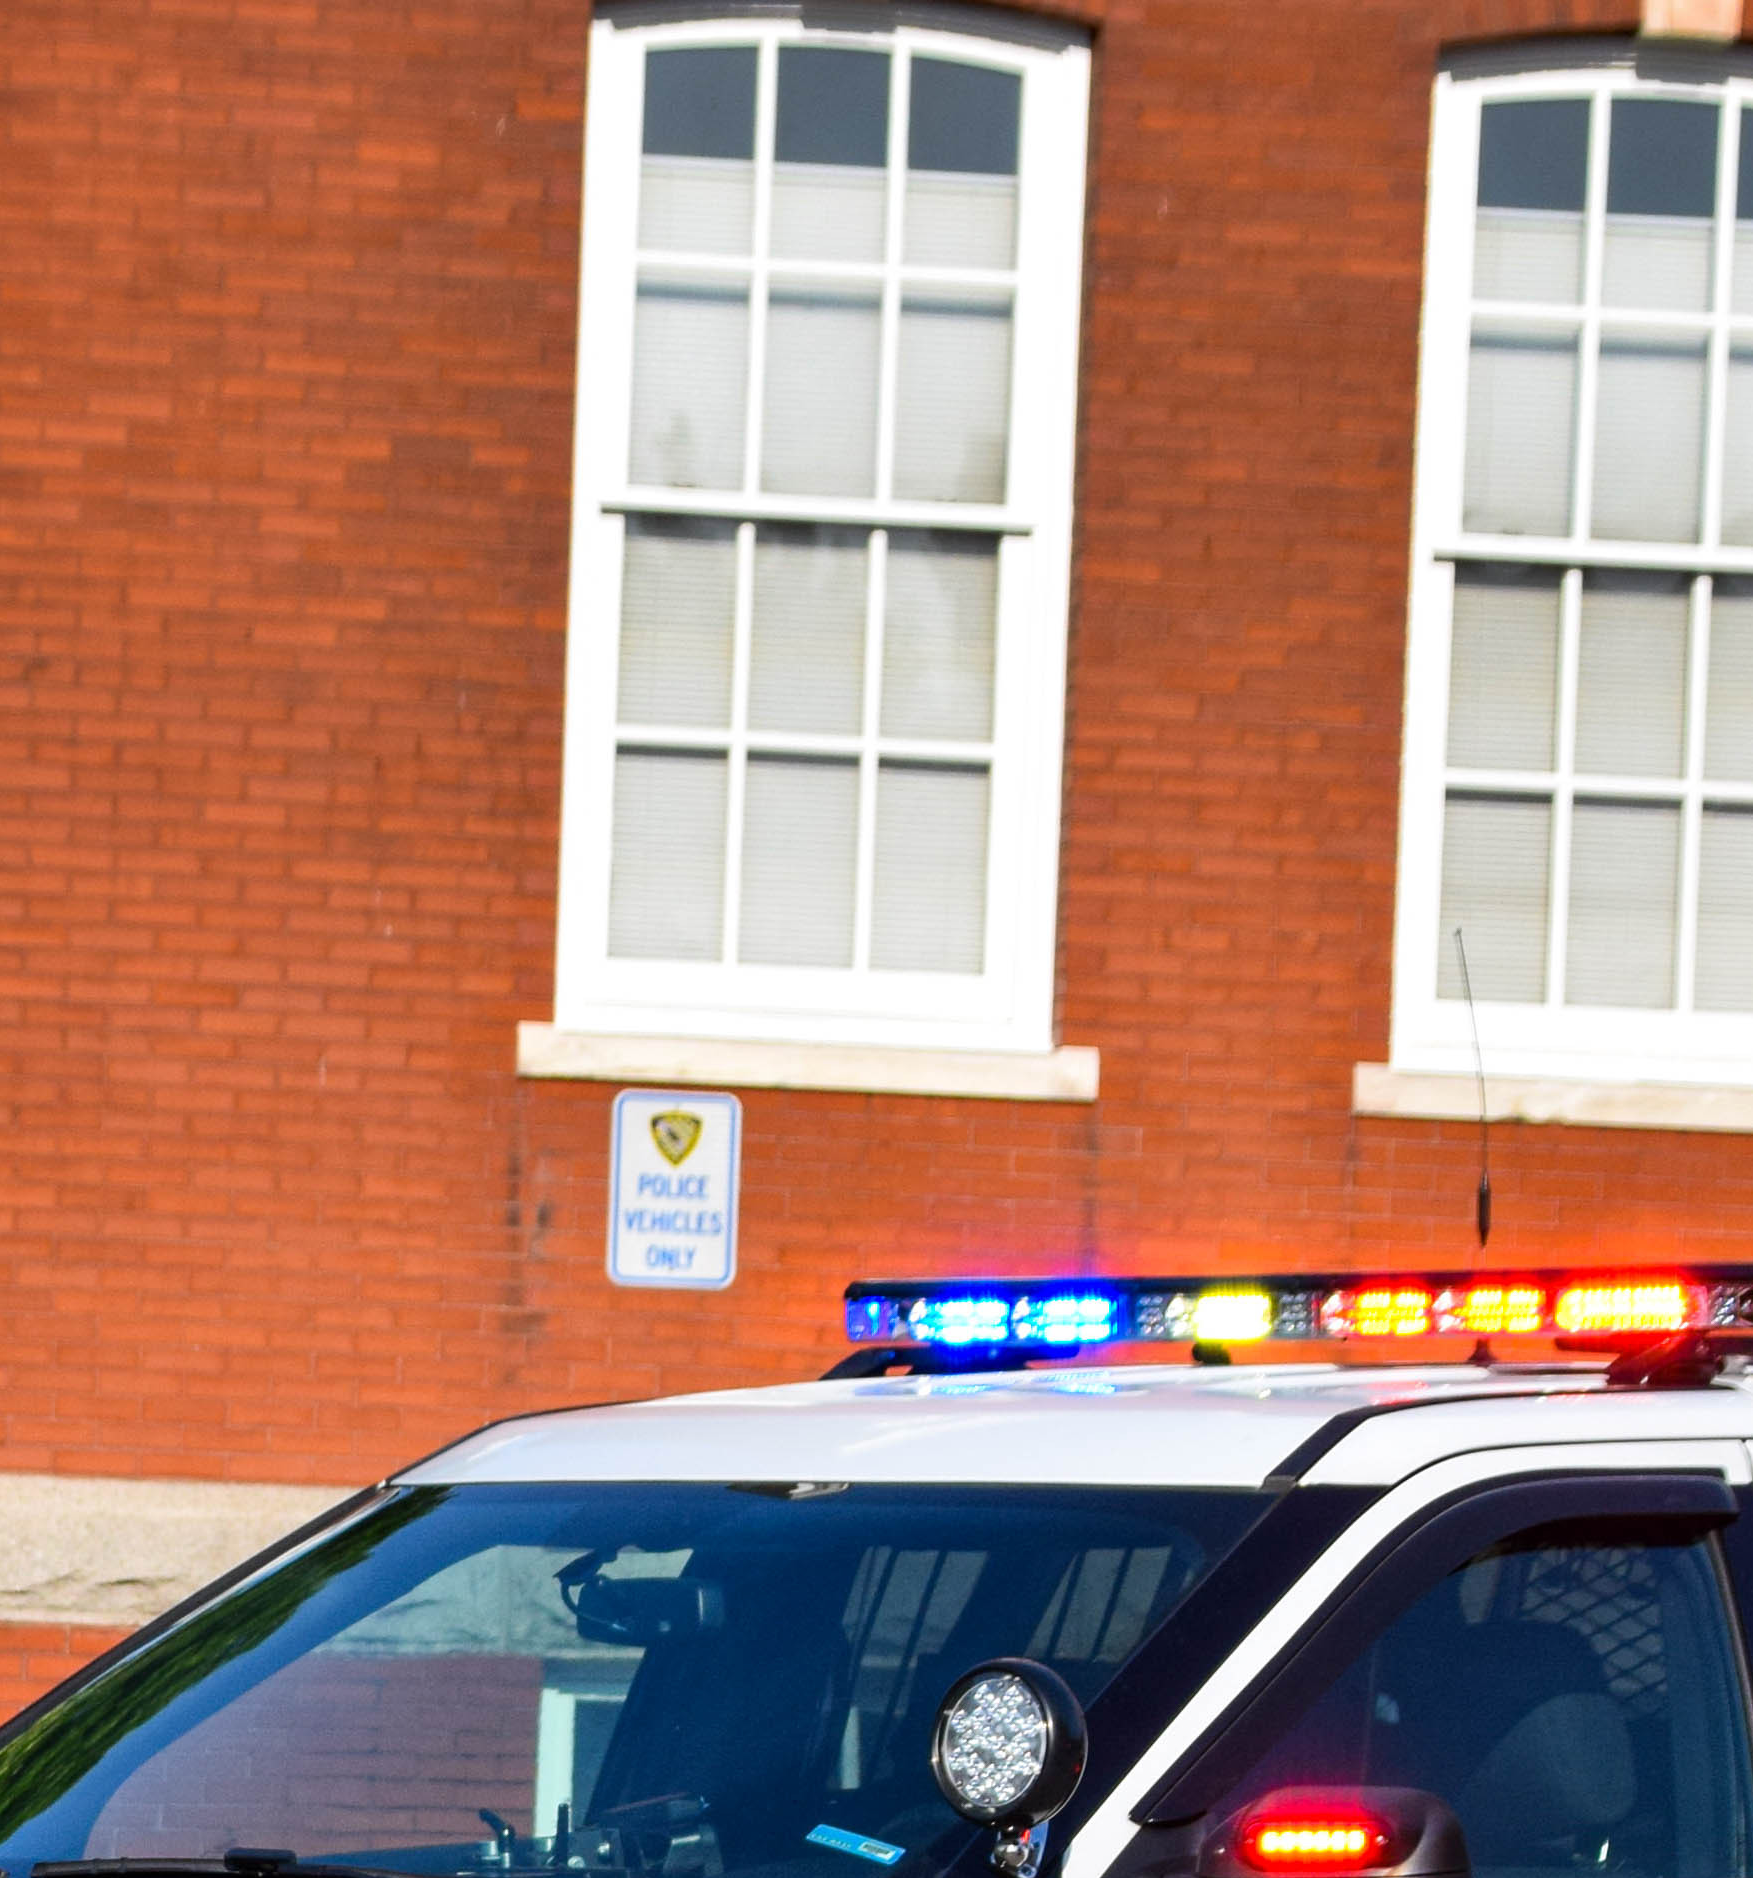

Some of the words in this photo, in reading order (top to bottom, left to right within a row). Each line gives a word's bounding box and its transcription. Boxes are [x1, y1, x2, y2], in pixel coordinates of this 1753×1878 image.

[637, 1173, 710, 1199] POLICE
[625, 1208, 722, 1237] VEHICLES
[645, 1243, 696, 1269] ONLY
